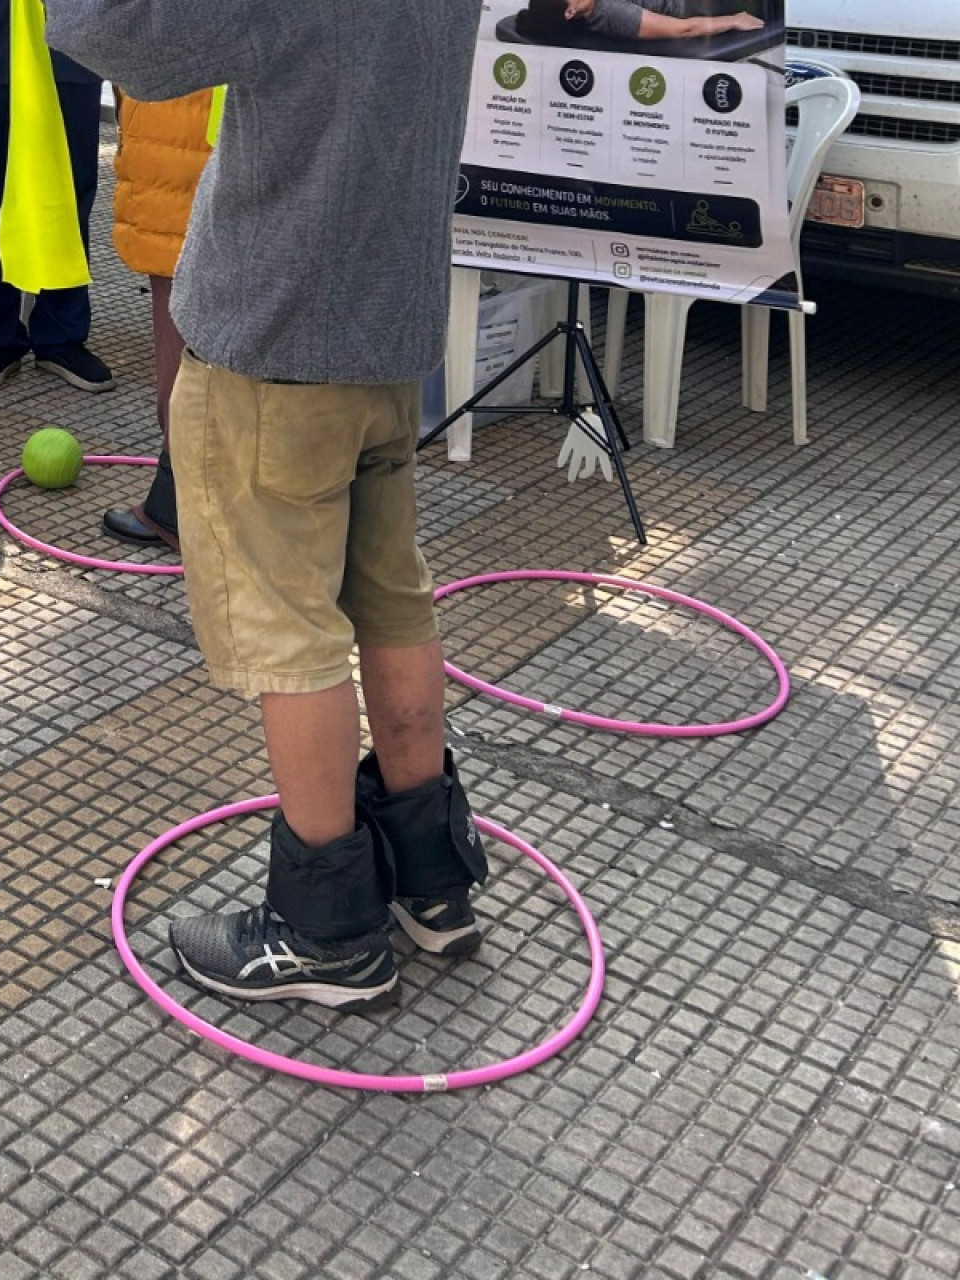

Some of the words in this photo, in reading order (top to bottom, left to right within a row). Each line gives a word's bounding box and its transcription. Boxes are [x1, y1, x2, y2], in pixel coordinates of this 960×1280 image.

[480, 180, 498, 192] SEU
[500, 183, 575, 204] CONHECIMENTO
[576, 193, 591, 204] EM
[480, 196, 488, 206] O
[490, 197, 532, 211] FUTURO
[532, 202, 548, 213] EM
[549, 204, 578, 217] SUAS
